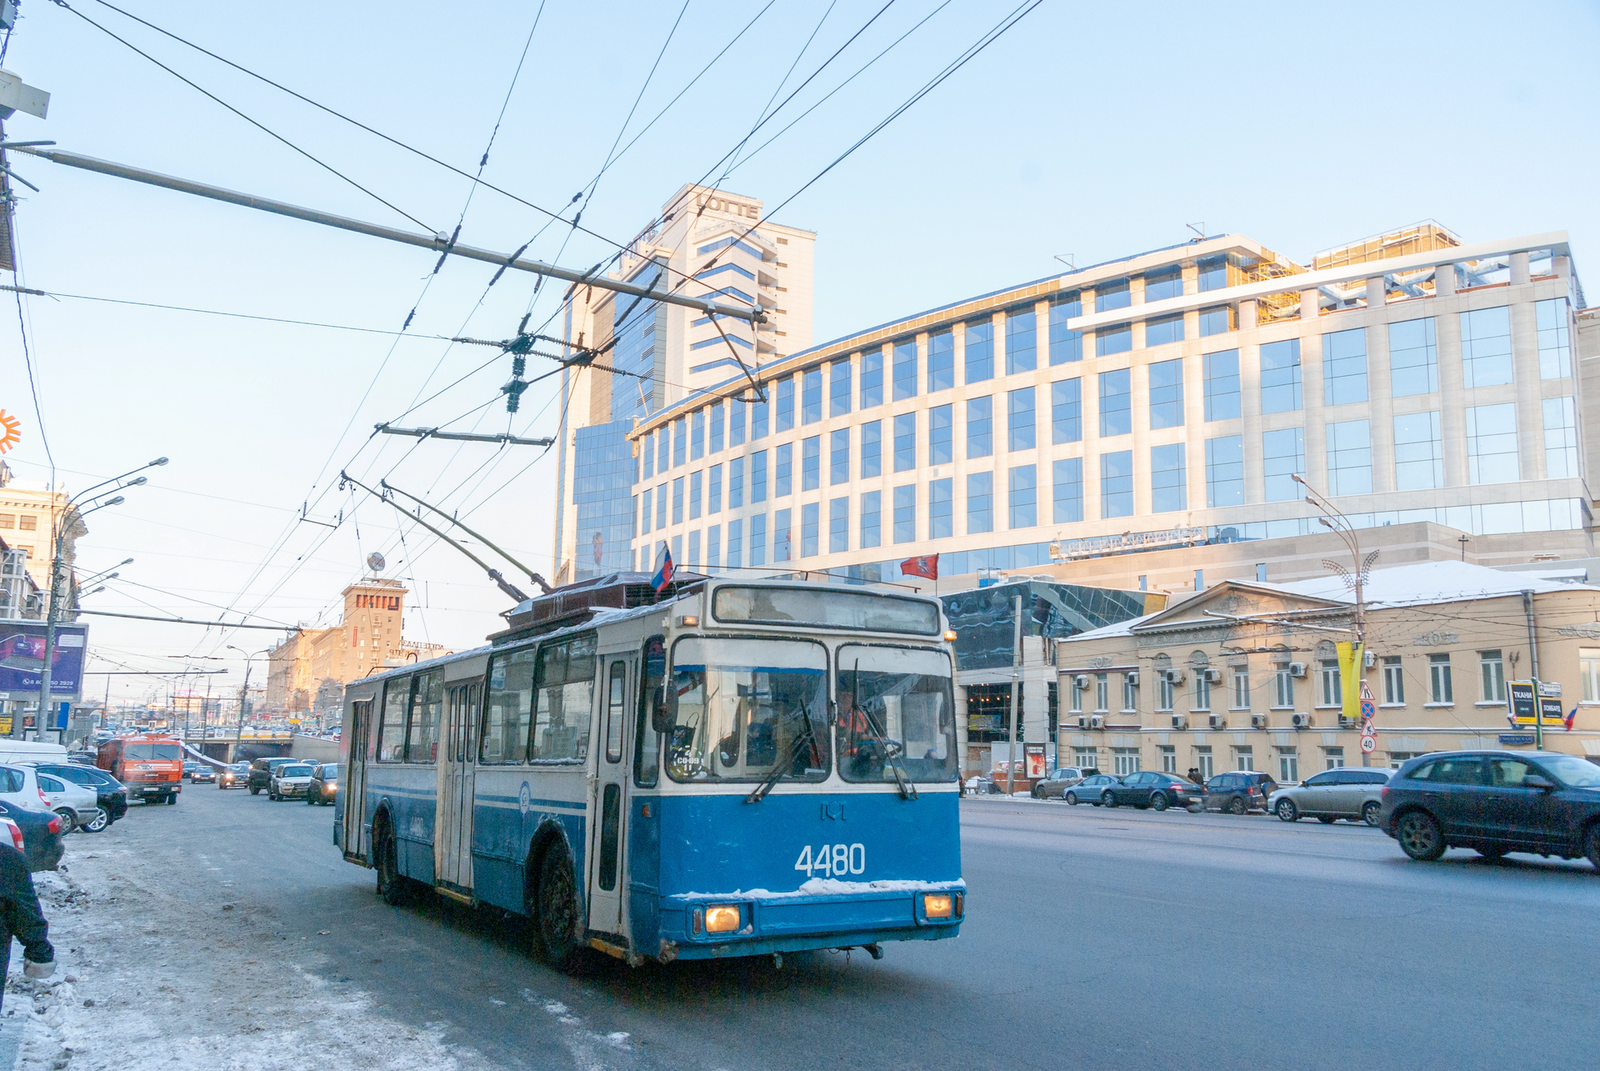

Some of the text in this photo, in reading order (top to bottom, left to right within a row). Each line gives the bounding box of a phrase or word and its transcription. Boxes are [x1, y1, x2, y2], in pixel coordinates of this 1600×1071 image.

[696, 195, 758, 220] LOTTE
[1513, 691, 1532, 699] ТКАНИ
[1363, 740, 1373, 749] 40
[794, 843, 865, 877] 4480
